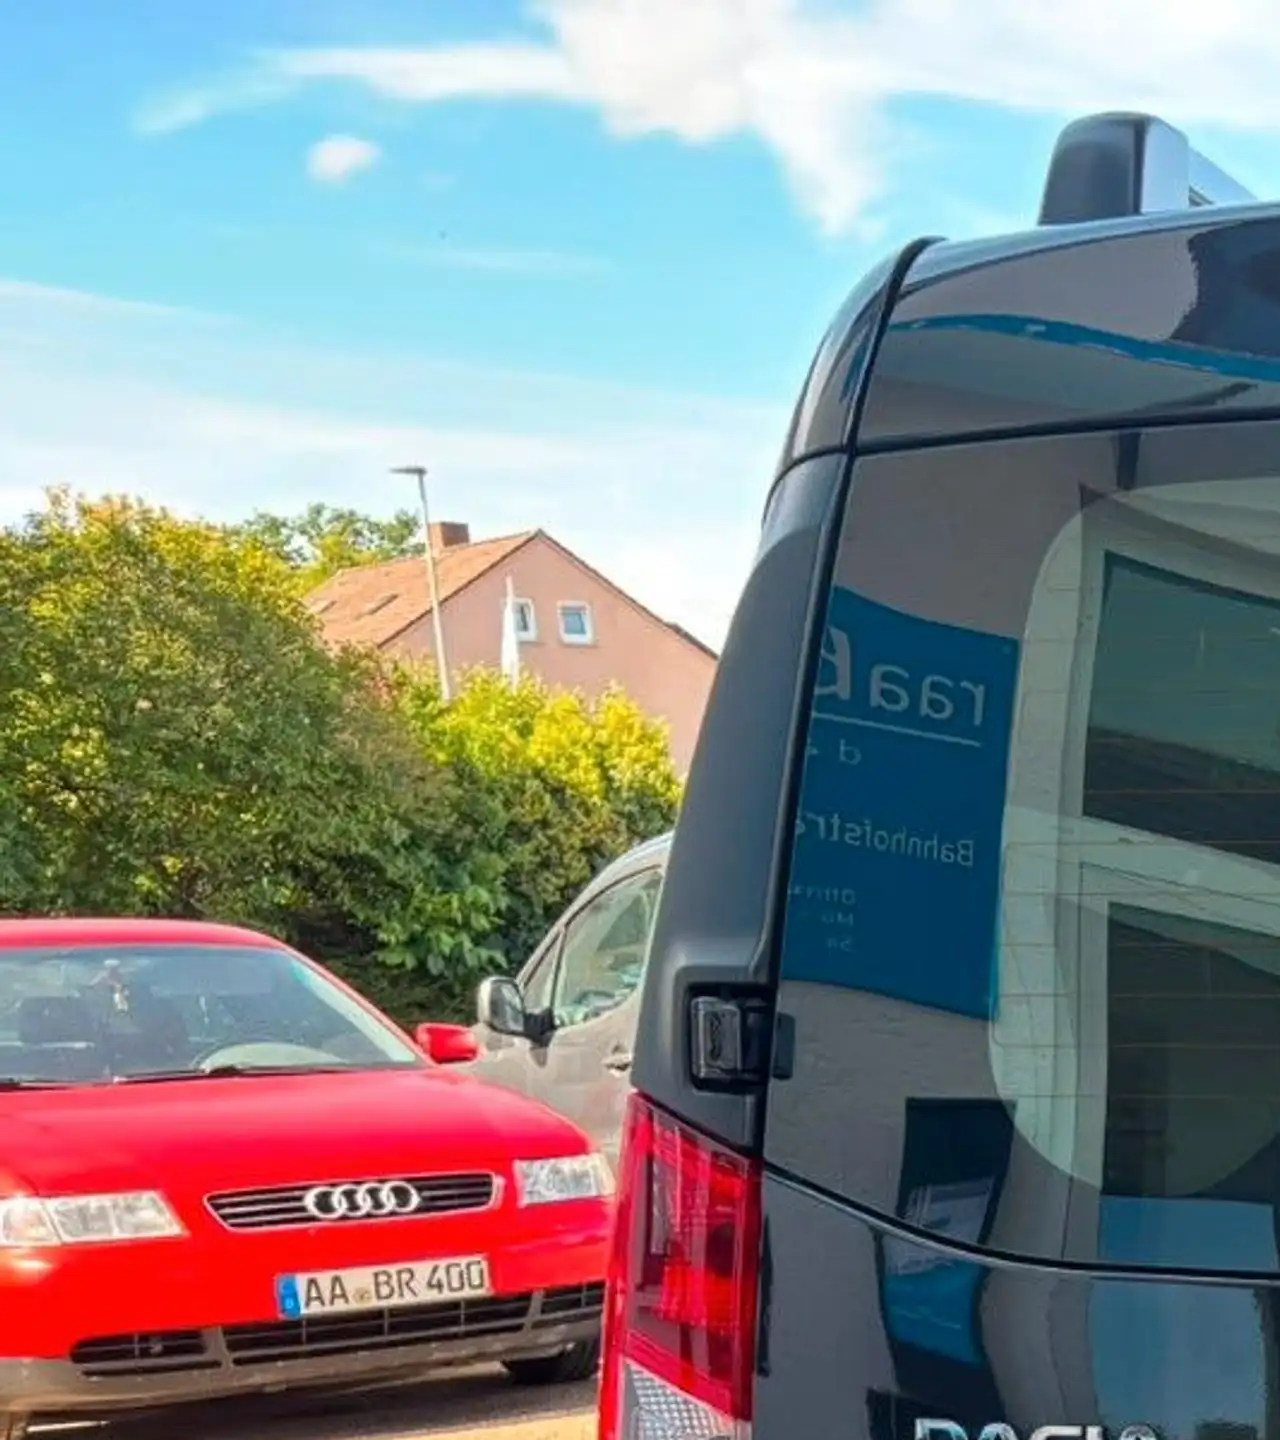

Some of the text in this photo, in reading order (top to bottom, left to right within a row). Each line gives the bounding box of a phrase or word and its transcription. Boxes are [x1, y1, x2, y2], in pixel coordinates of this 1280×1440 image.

[304, 1259, 485, 1308] AA BR 400
